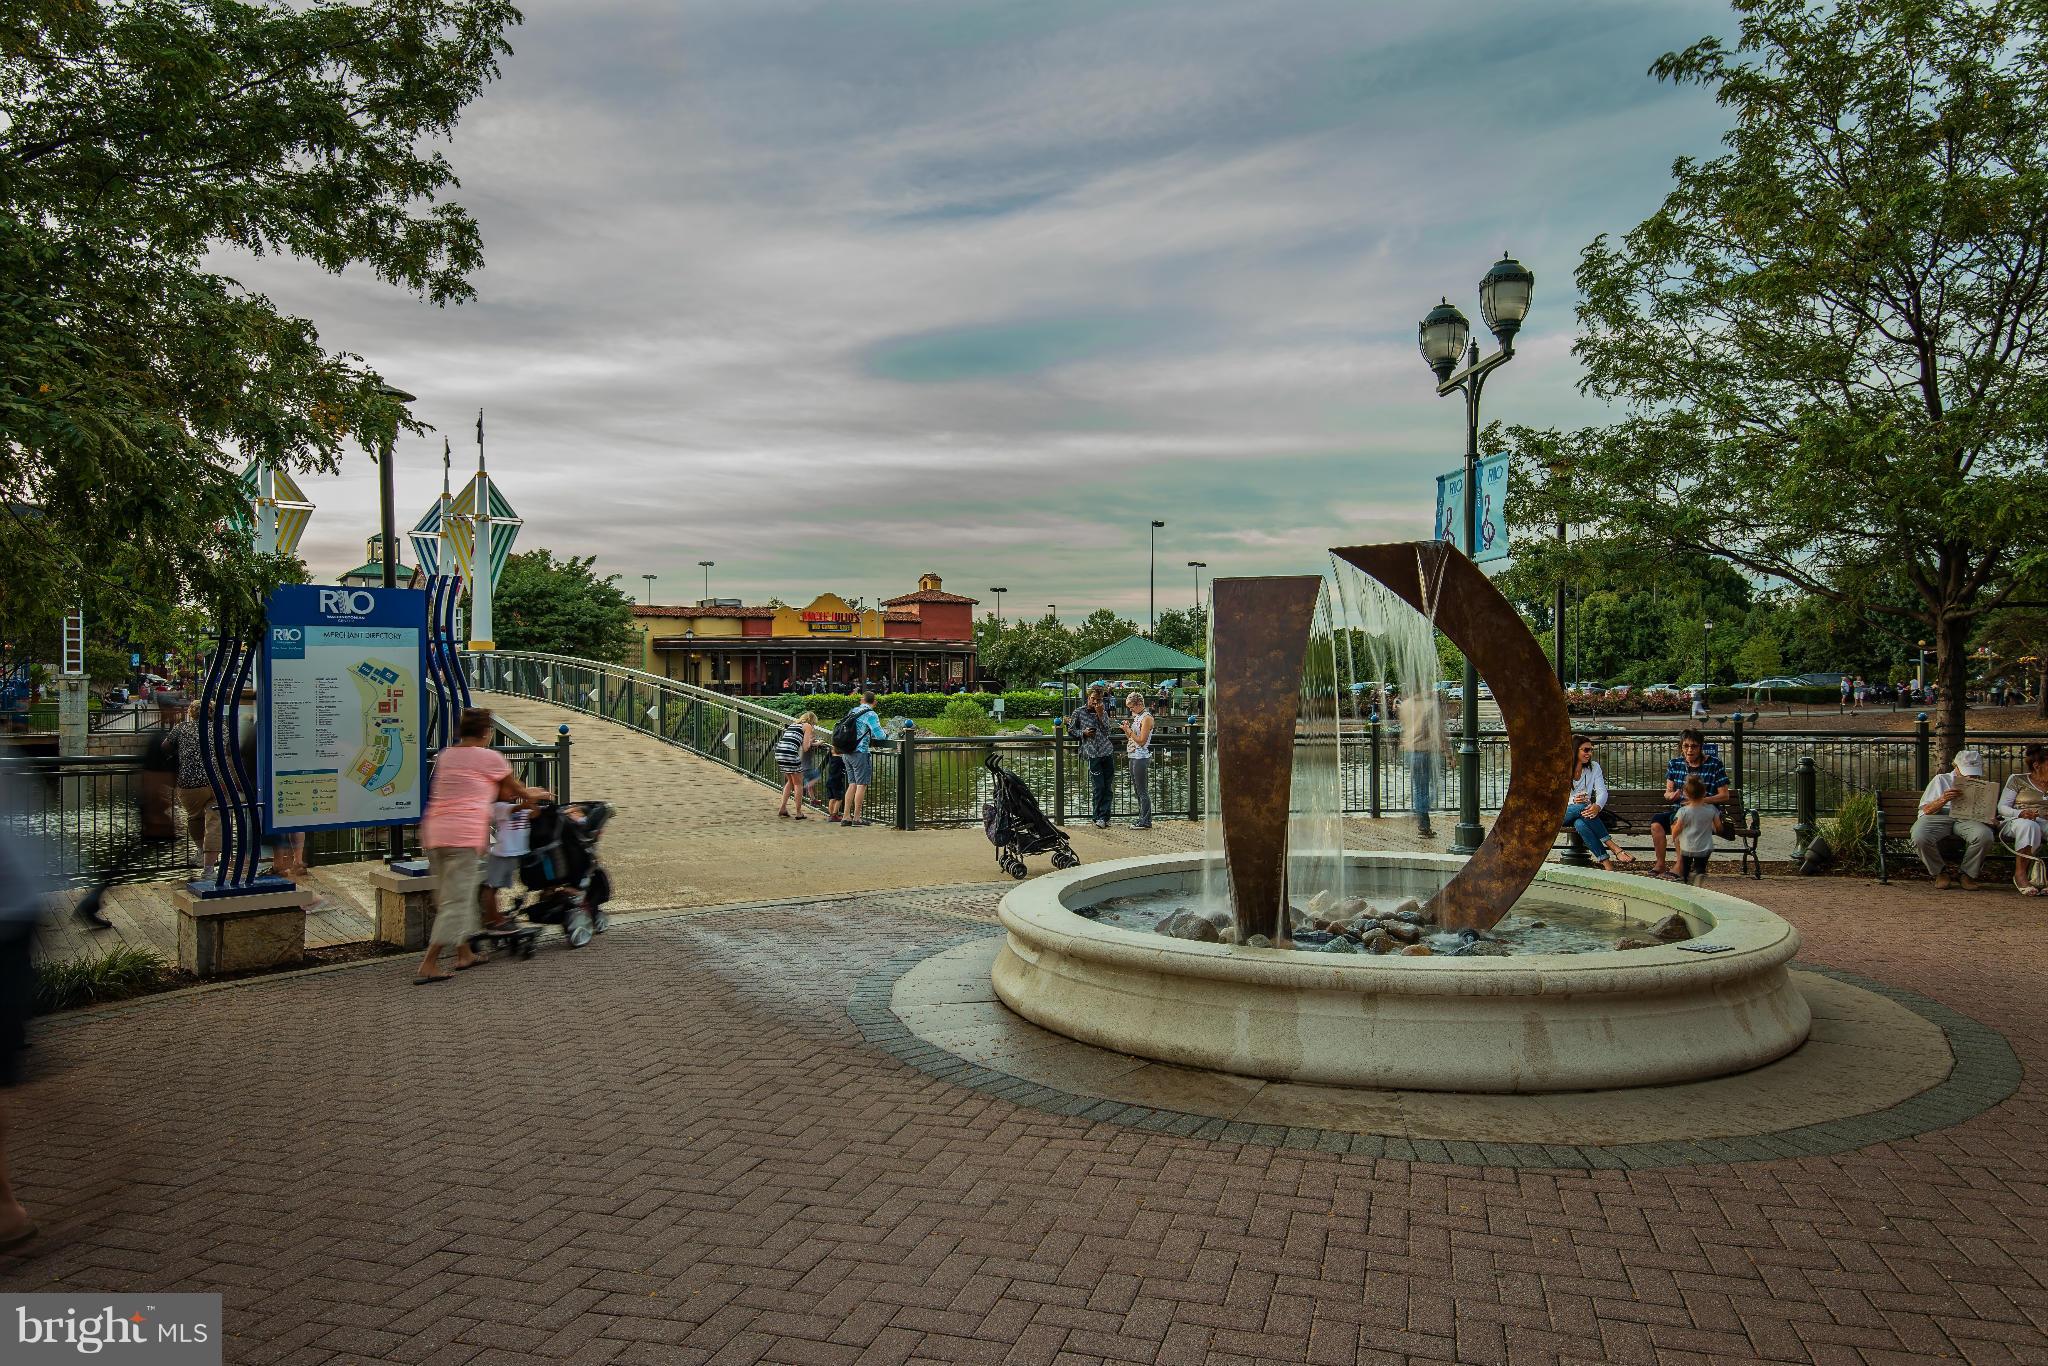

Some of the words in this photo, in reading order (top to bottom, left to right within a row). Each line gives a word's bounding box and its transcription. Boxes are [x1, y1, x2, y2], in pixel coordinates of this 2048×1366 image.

[319, 589, 375, 615] RIO
[273, 628, 302, 641] RIO
[323, 631, 363, 639] MERCHANT
[365, 632, 402, 640] DIRECTORY
